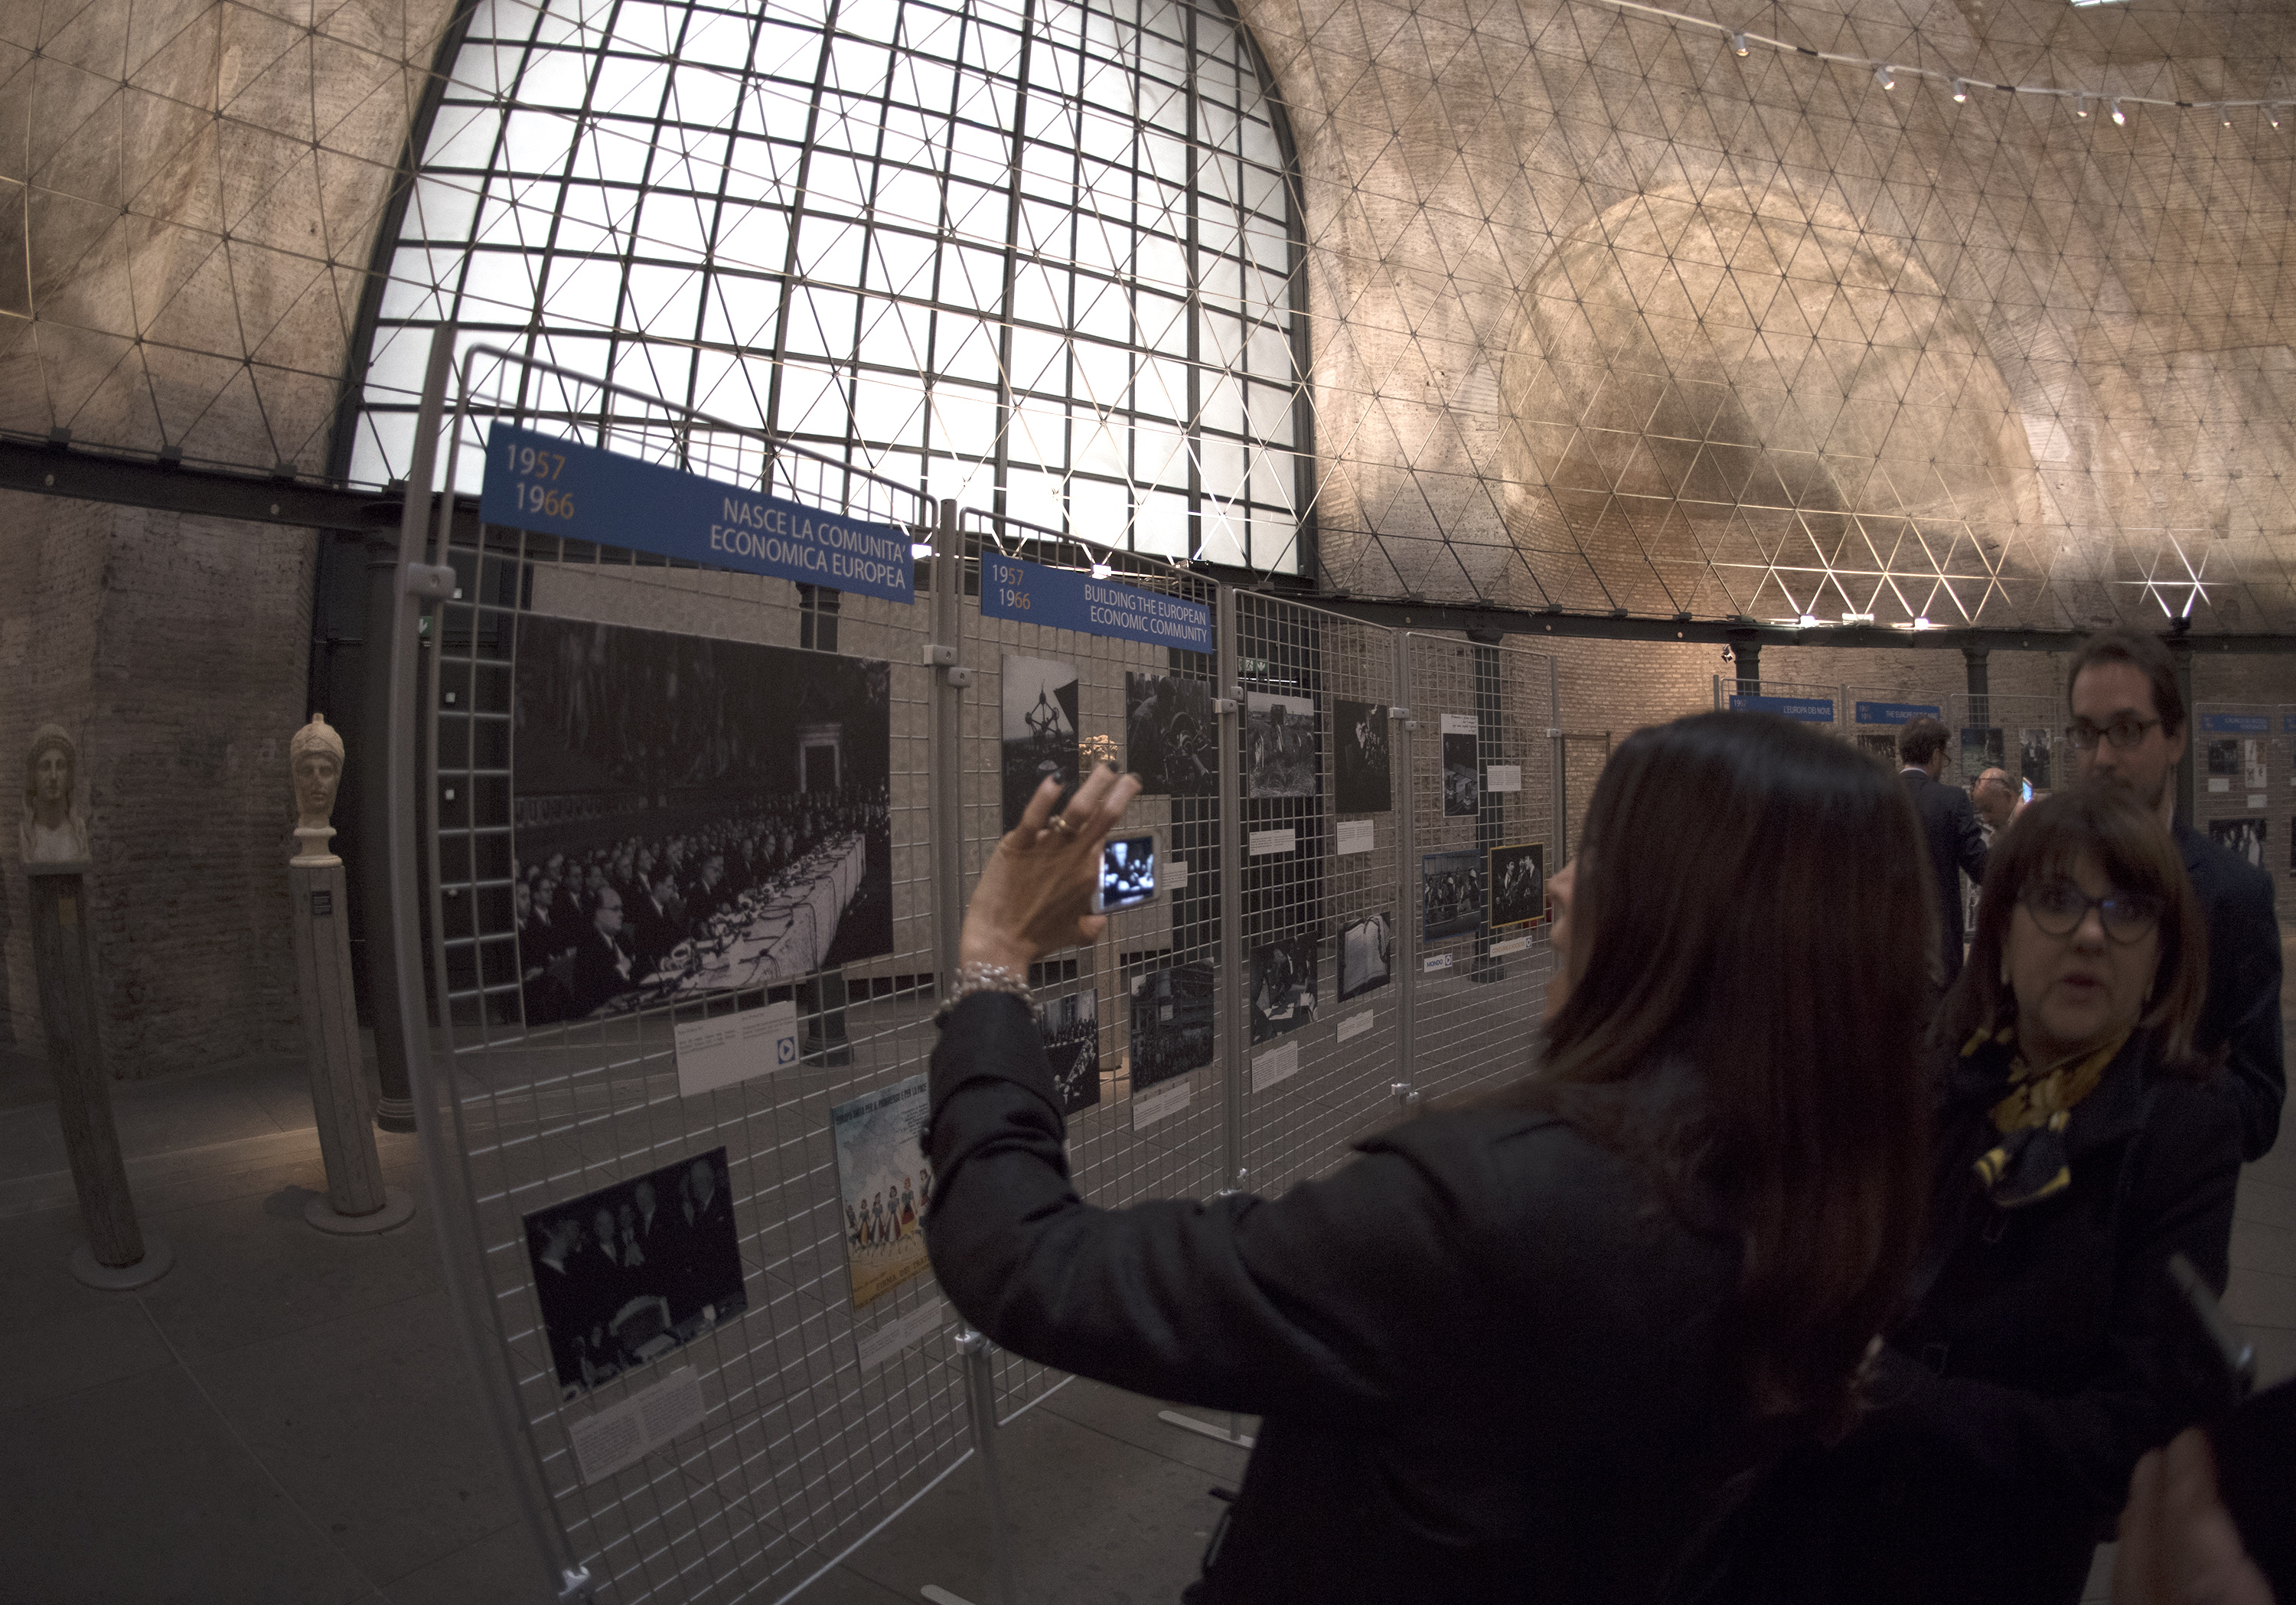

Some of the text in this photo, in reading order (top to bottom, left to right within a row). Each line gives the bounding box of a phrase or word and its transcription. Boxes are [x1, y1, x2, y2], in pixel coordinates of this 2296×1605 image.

[507, 444, 566, 480] 1957
[516, 482, 574, 520] 1966
[723, 497, 907, 564] NASCE LA COMUNITA'
[710, 525, 906, 589] ECONOMICA EUROPEA
[993, 564, 1024, 586] 1957
[999, 589, 1031, 610] 1966
[1084, 584, 1206, 626] BUILDING THE EUROPEAN
[1091, 605, 1208, 643] ECONOMIC COMMUNITY
[1427, 958, 1443, 967] MONDO
[904, 1088, 912, 1098] PER
[912, 1086, 918, 1095] LA
[918, 1083, 928, 1094] PACE
